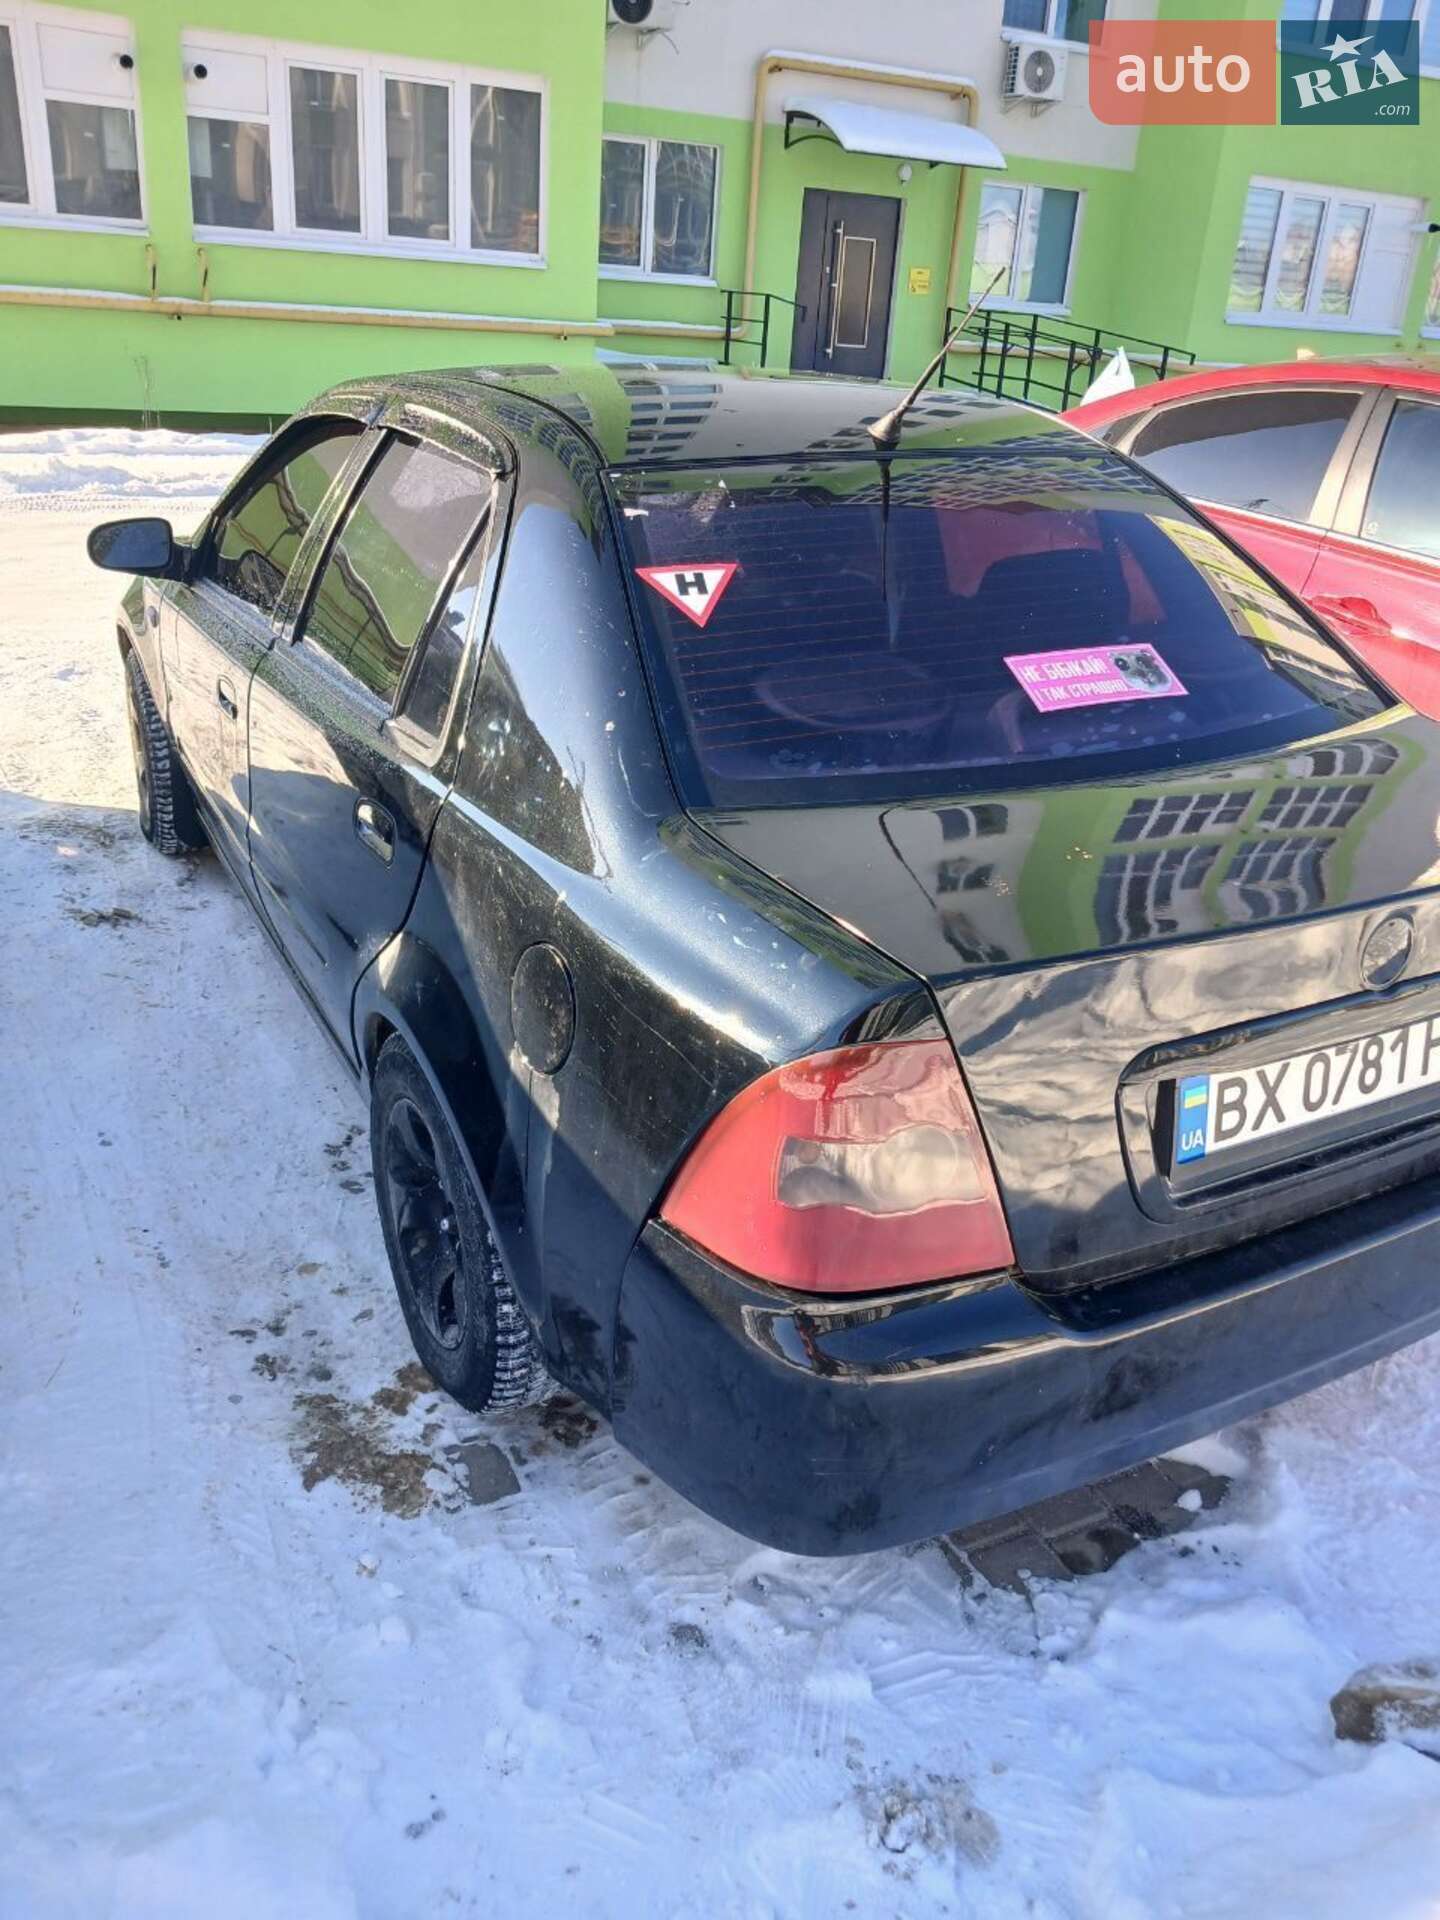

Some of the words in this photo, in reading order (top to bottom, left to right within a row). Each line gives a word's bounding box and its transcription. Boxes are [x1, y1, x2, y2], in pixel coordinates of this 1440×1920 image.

[674, 572, 708, 595] Н
[1018, 665, 1046, 683] НЕ
[1040, 686, 1070, 701] ТАК
[1213, 1062, 1290, 1143] BX
[1303, 1026, 1410, 1112] 0781
[1182, 1129, 1204, 1151] UA
